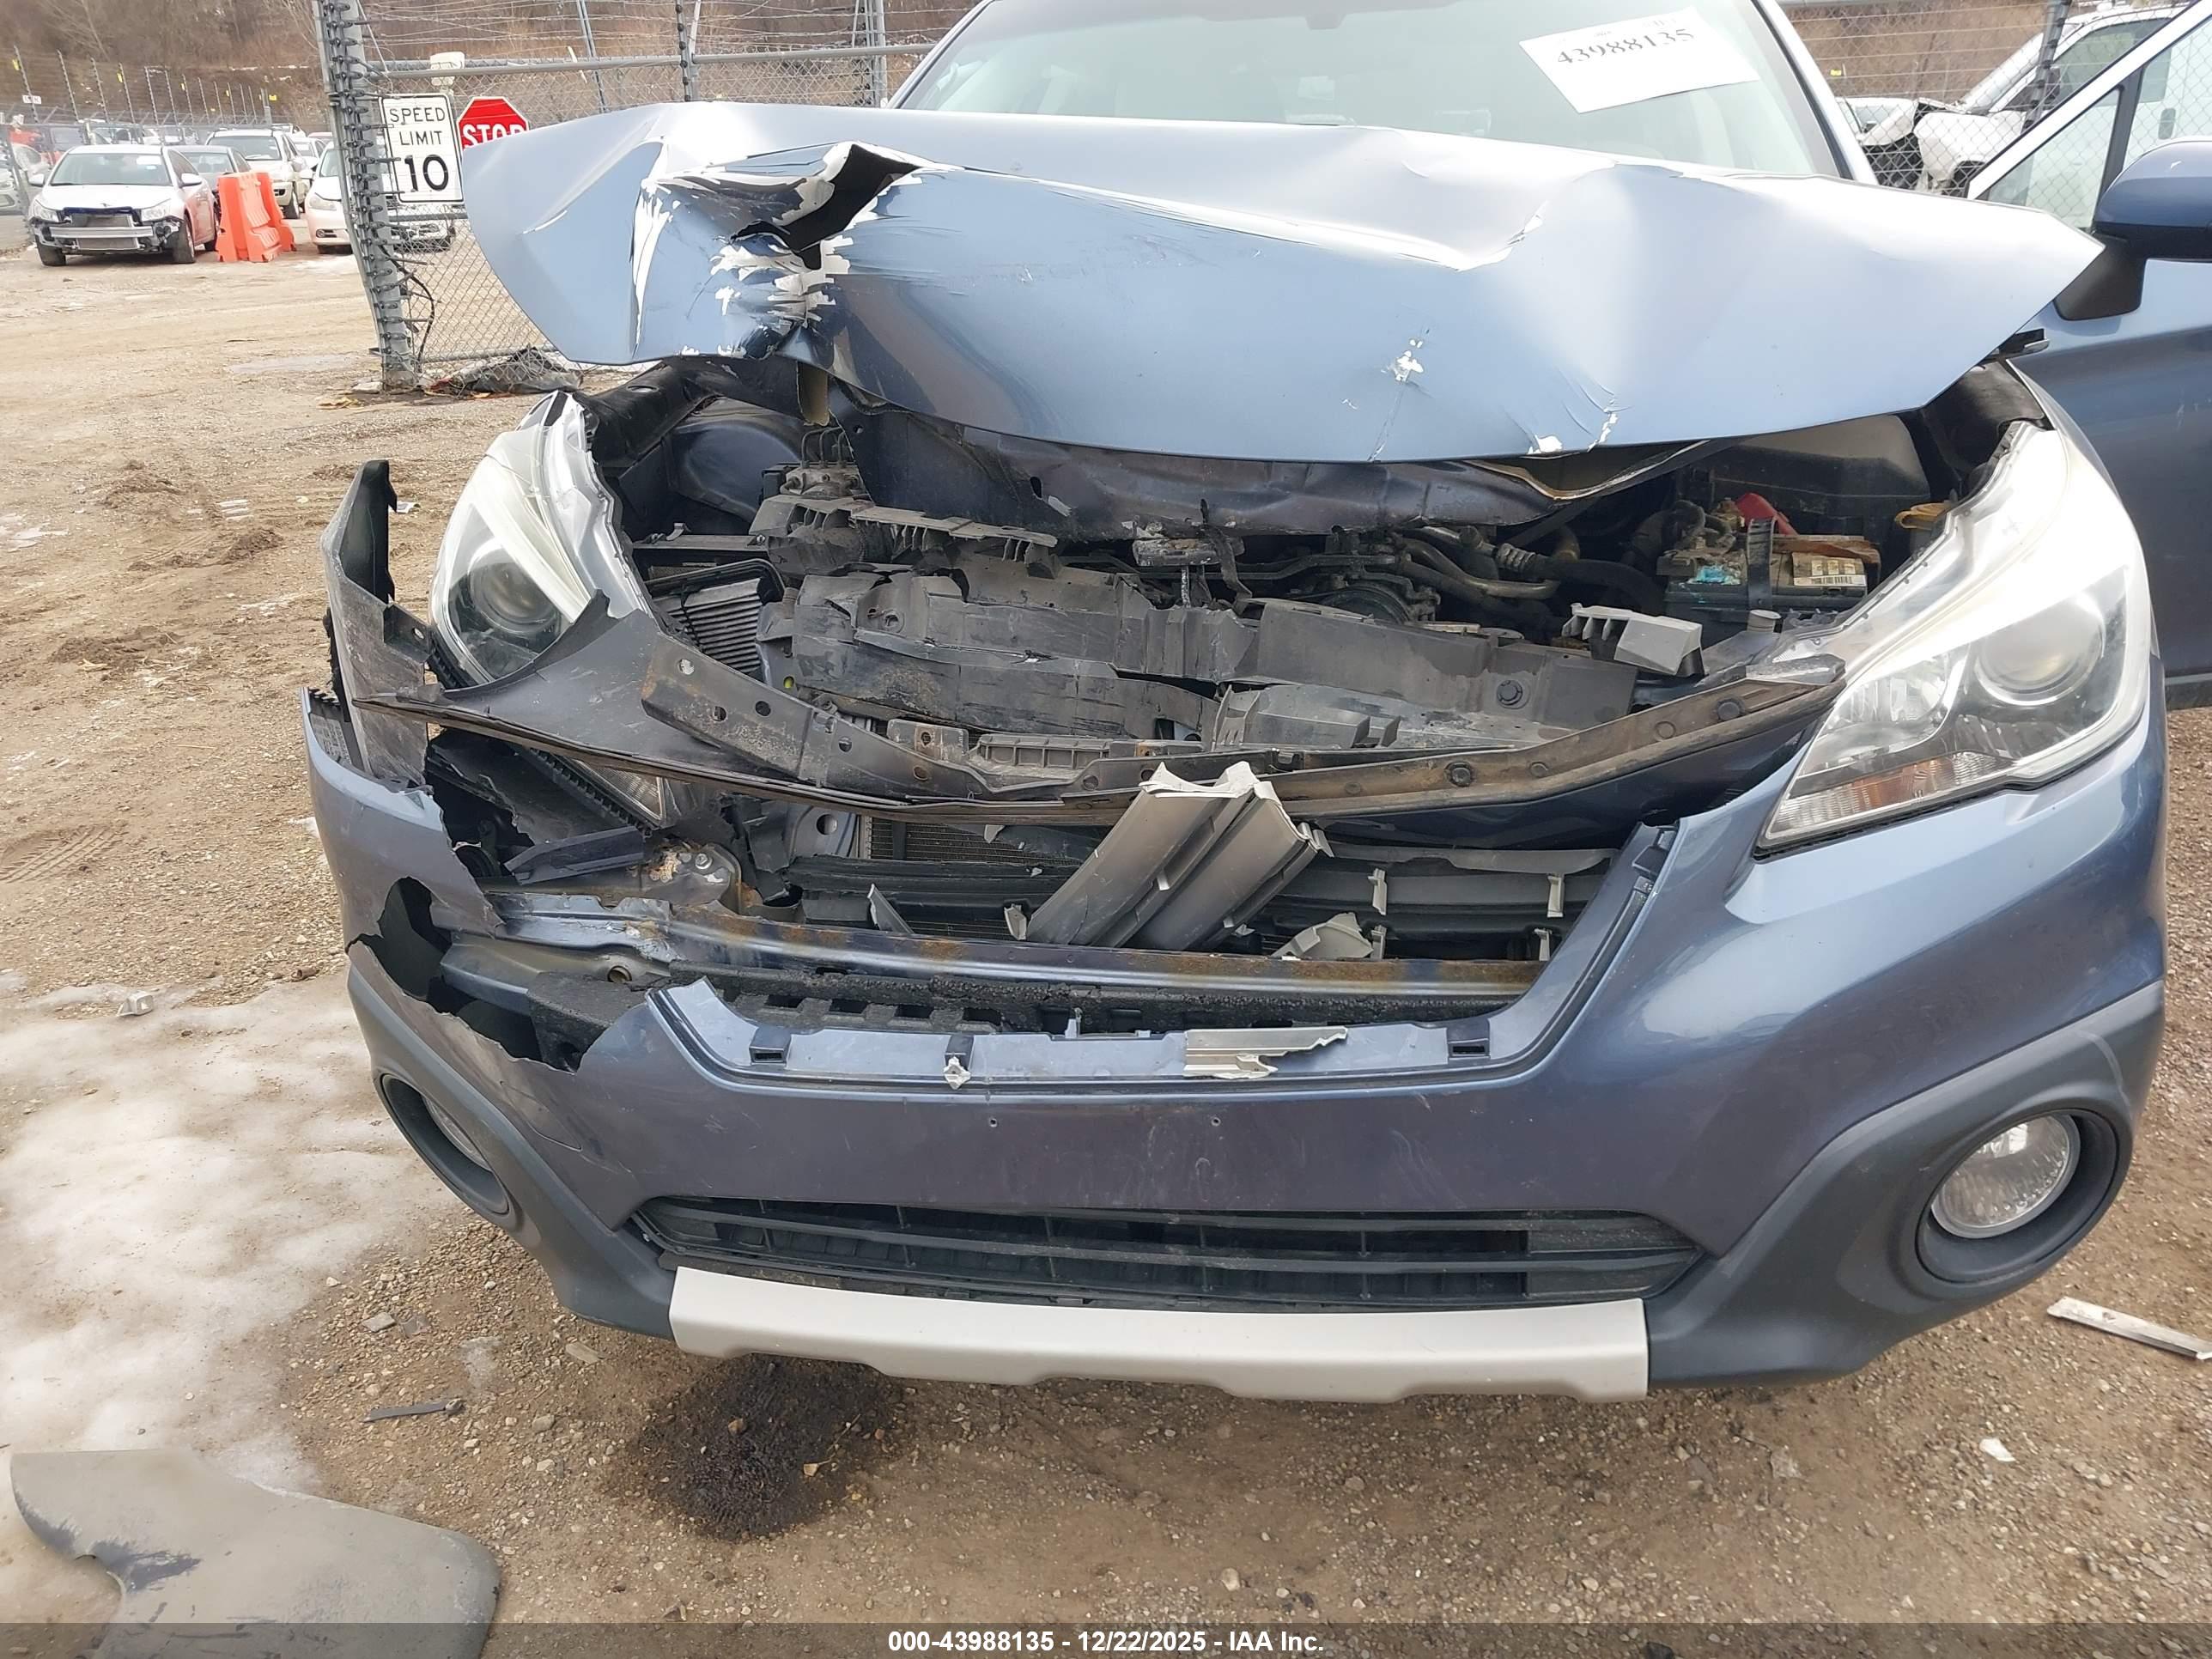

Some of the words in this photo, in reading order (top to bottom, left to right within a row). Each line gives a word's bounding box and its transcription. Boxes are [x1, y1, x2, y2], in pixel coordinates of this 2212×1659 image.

[1558, 28, 1694, 64] 43988135
[389, 106, 446, 124] SPEED
[398, 130, 443, 146] LIMIT
[404, 154, 449, 192] 10
